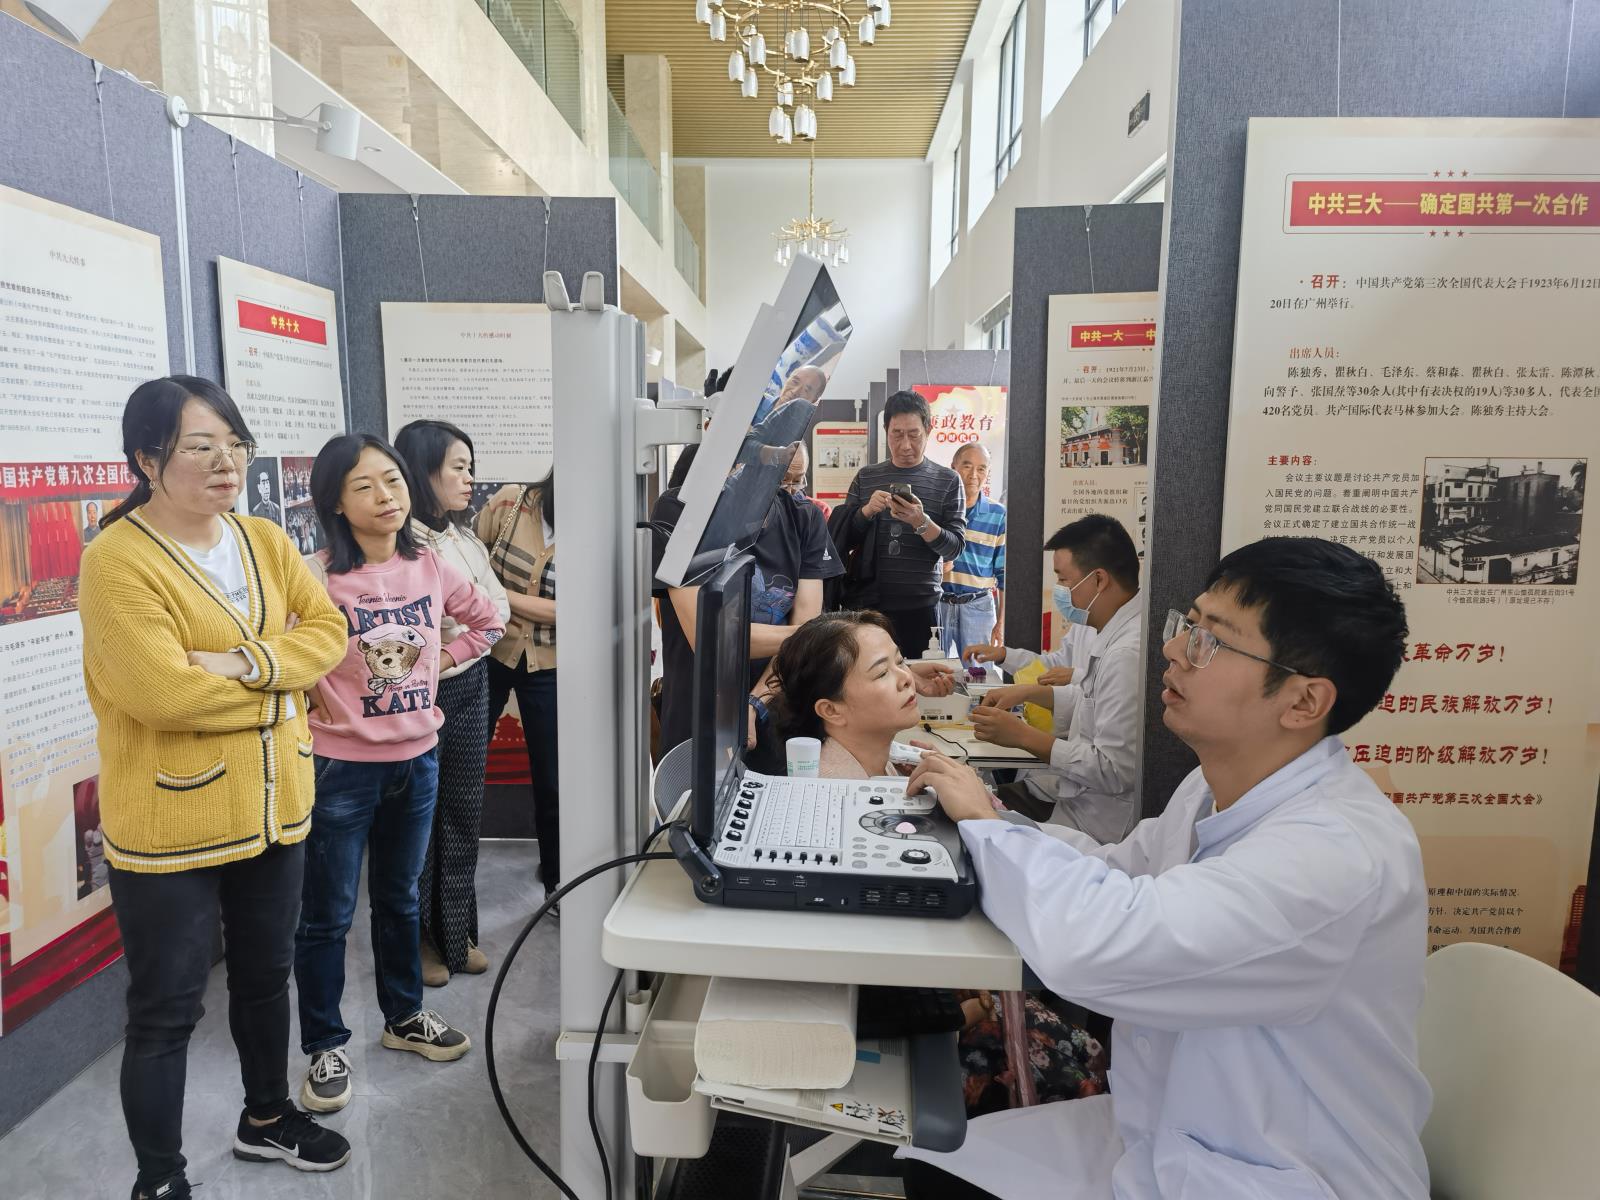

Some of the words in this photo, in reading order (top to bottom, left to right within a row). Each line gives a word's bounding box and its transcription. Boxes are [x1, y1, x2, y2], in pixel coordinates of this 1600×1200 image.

[271, 315, 300, 334] 中共十大
[1289, 347, 1340, 359] 出席人员:
[1267, 455, 1318, 466] 主要内容:
[1285, 473, 1420, 483] 会议主要议题是讨论共产党员加
[1264, 504, 1413, 514] 党同国民党建立联合战线的必要性。
[1263, 520, 1416, 529] 会议正式确定了建立国共合作统一战
[1381, 565, 1413, 575] 立和大
[338, 595, 434, 637] ARTIST
[360, 688, 431, 718] KATE
[1345, 743, 1548, 765] 压迫的阶级解放万岁!
